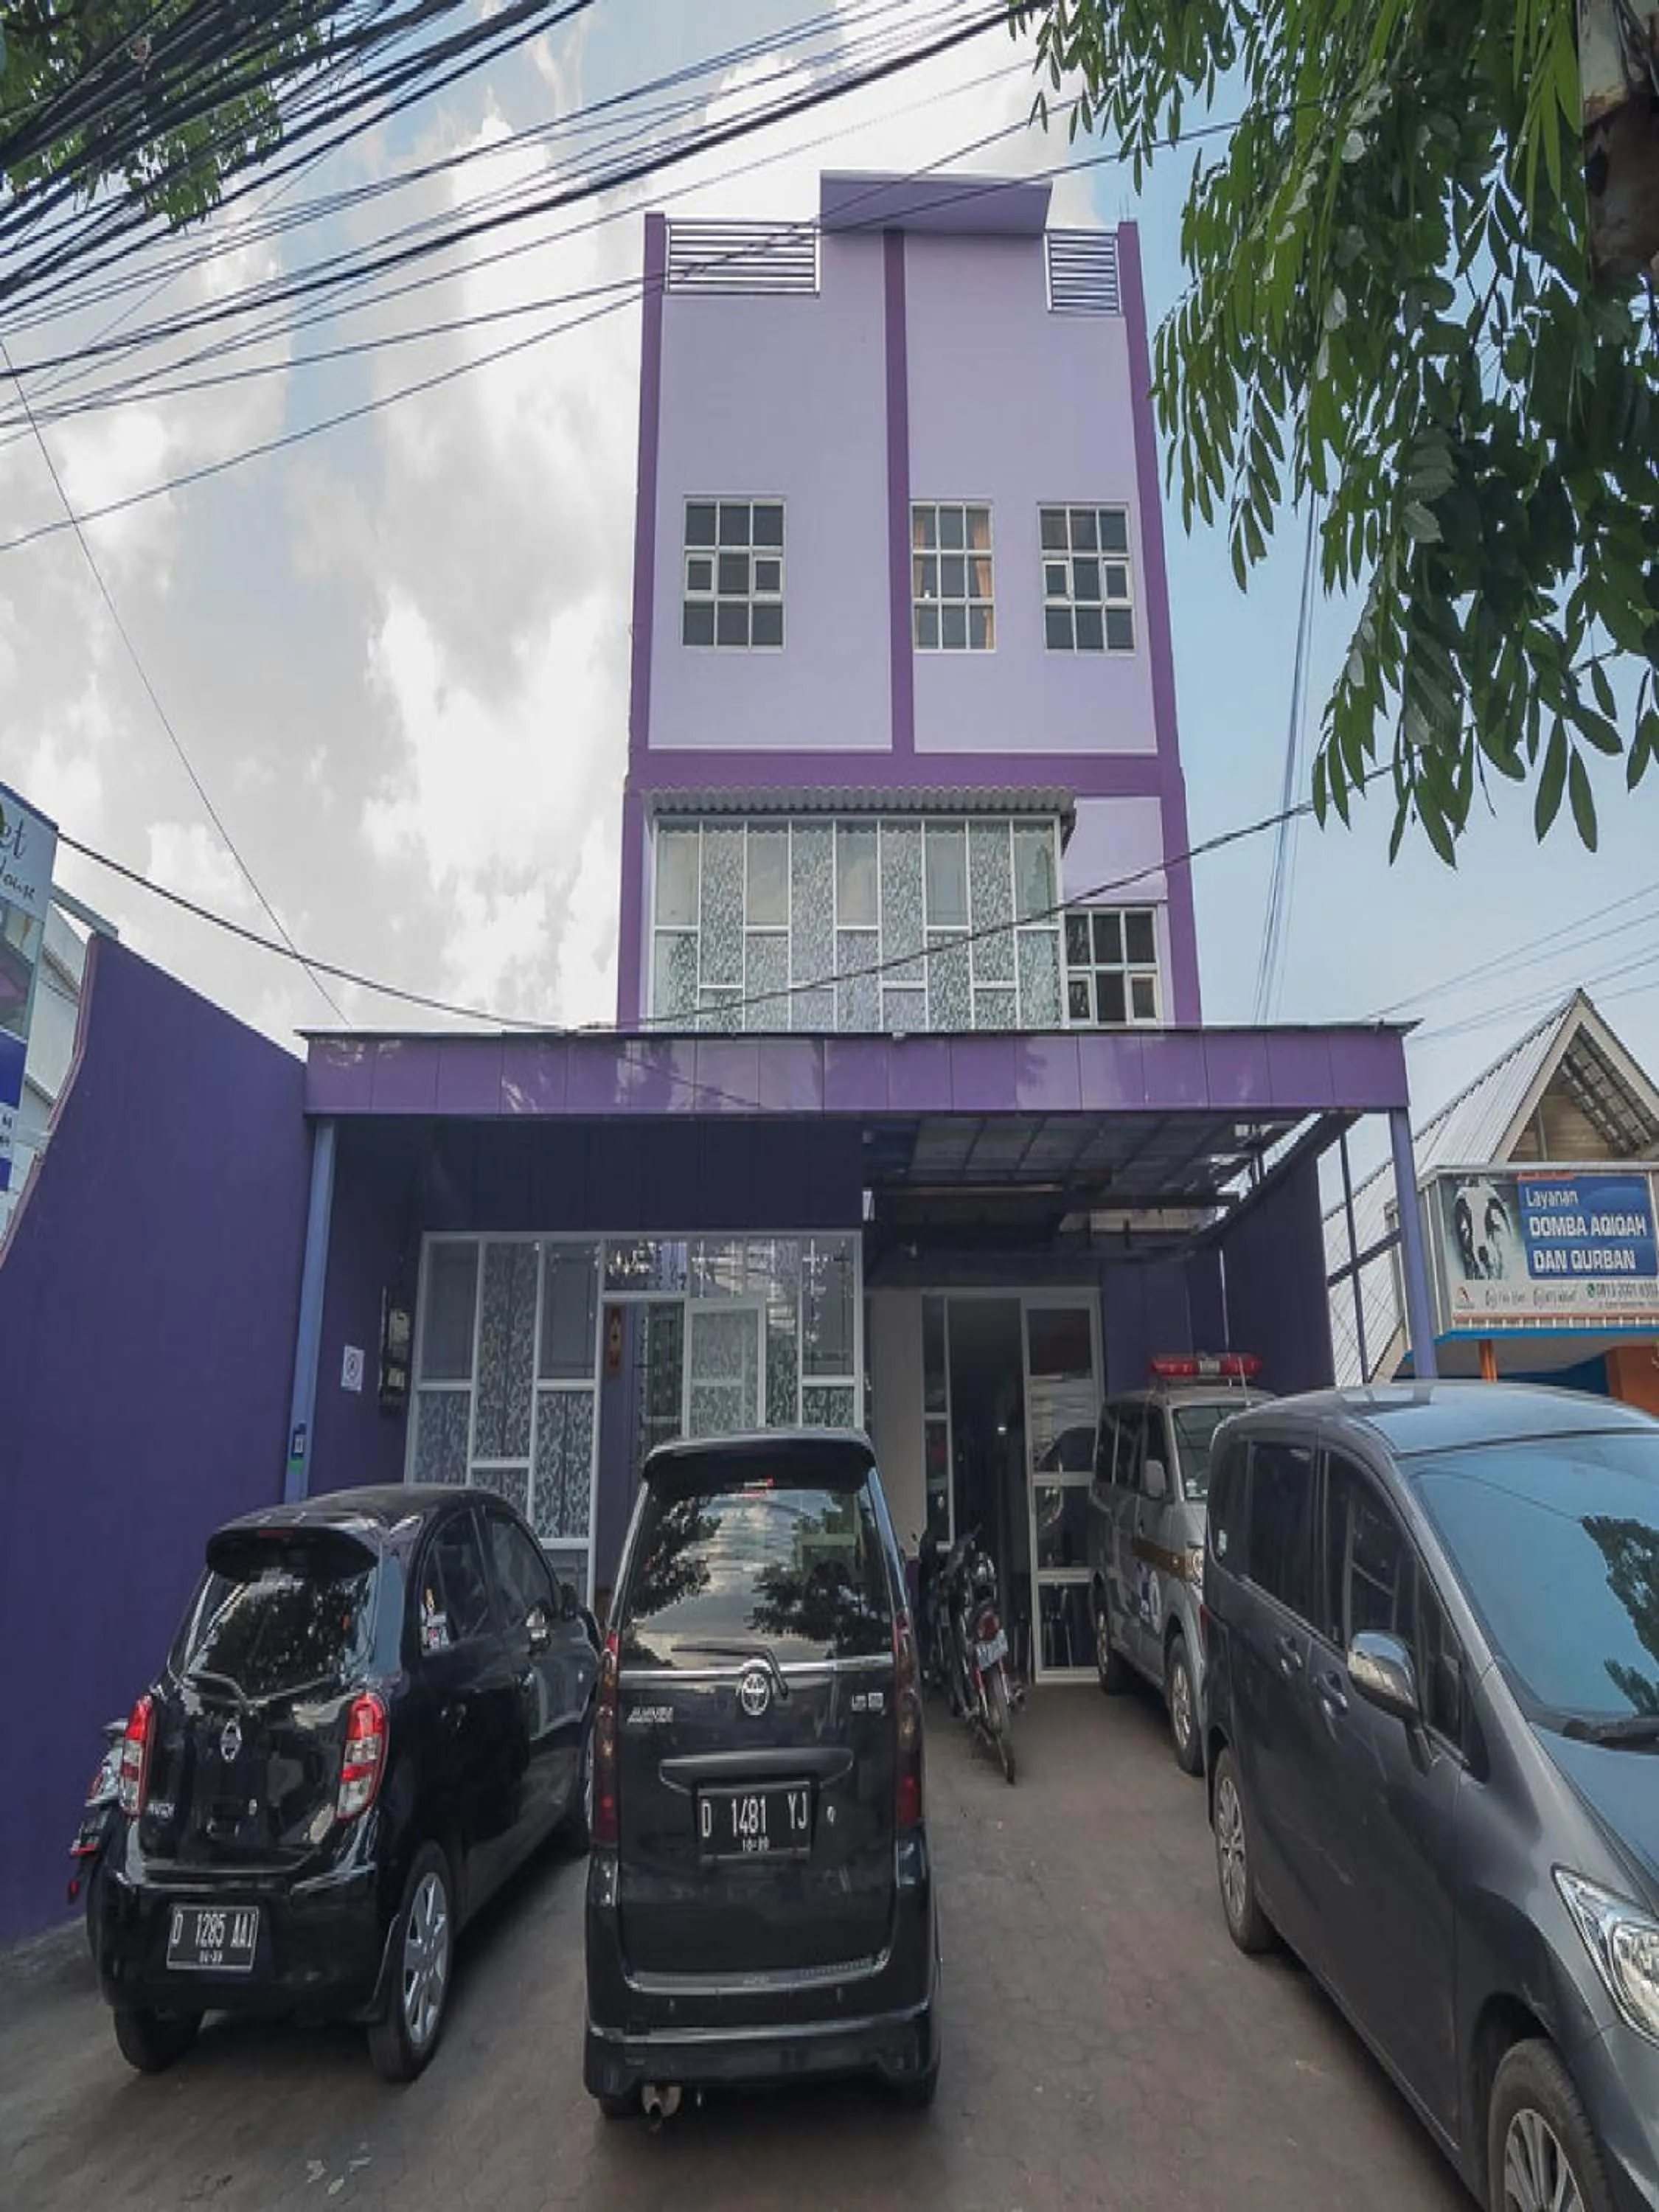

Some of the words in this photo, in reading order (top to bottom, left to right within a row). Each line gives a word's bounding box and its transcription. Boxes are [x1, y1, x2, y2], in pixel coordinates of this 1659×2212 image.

[1525, 1186, 1579, 1209] Layanan
[1529, 1215, 1588, 1237] DOMBA
[1590, 1214, 1647, 1237] AQIQAH
[1533, 1250, 1568, 1270] DAN
[1571, 1249, 1636, 1270] QURBAN
[702, 1801, 712, 1837] D
[731, 1795, 767, 1837] 1481
[788, 1791, 807, 1829] YJ
[172, 1913, 183, 1944] D
